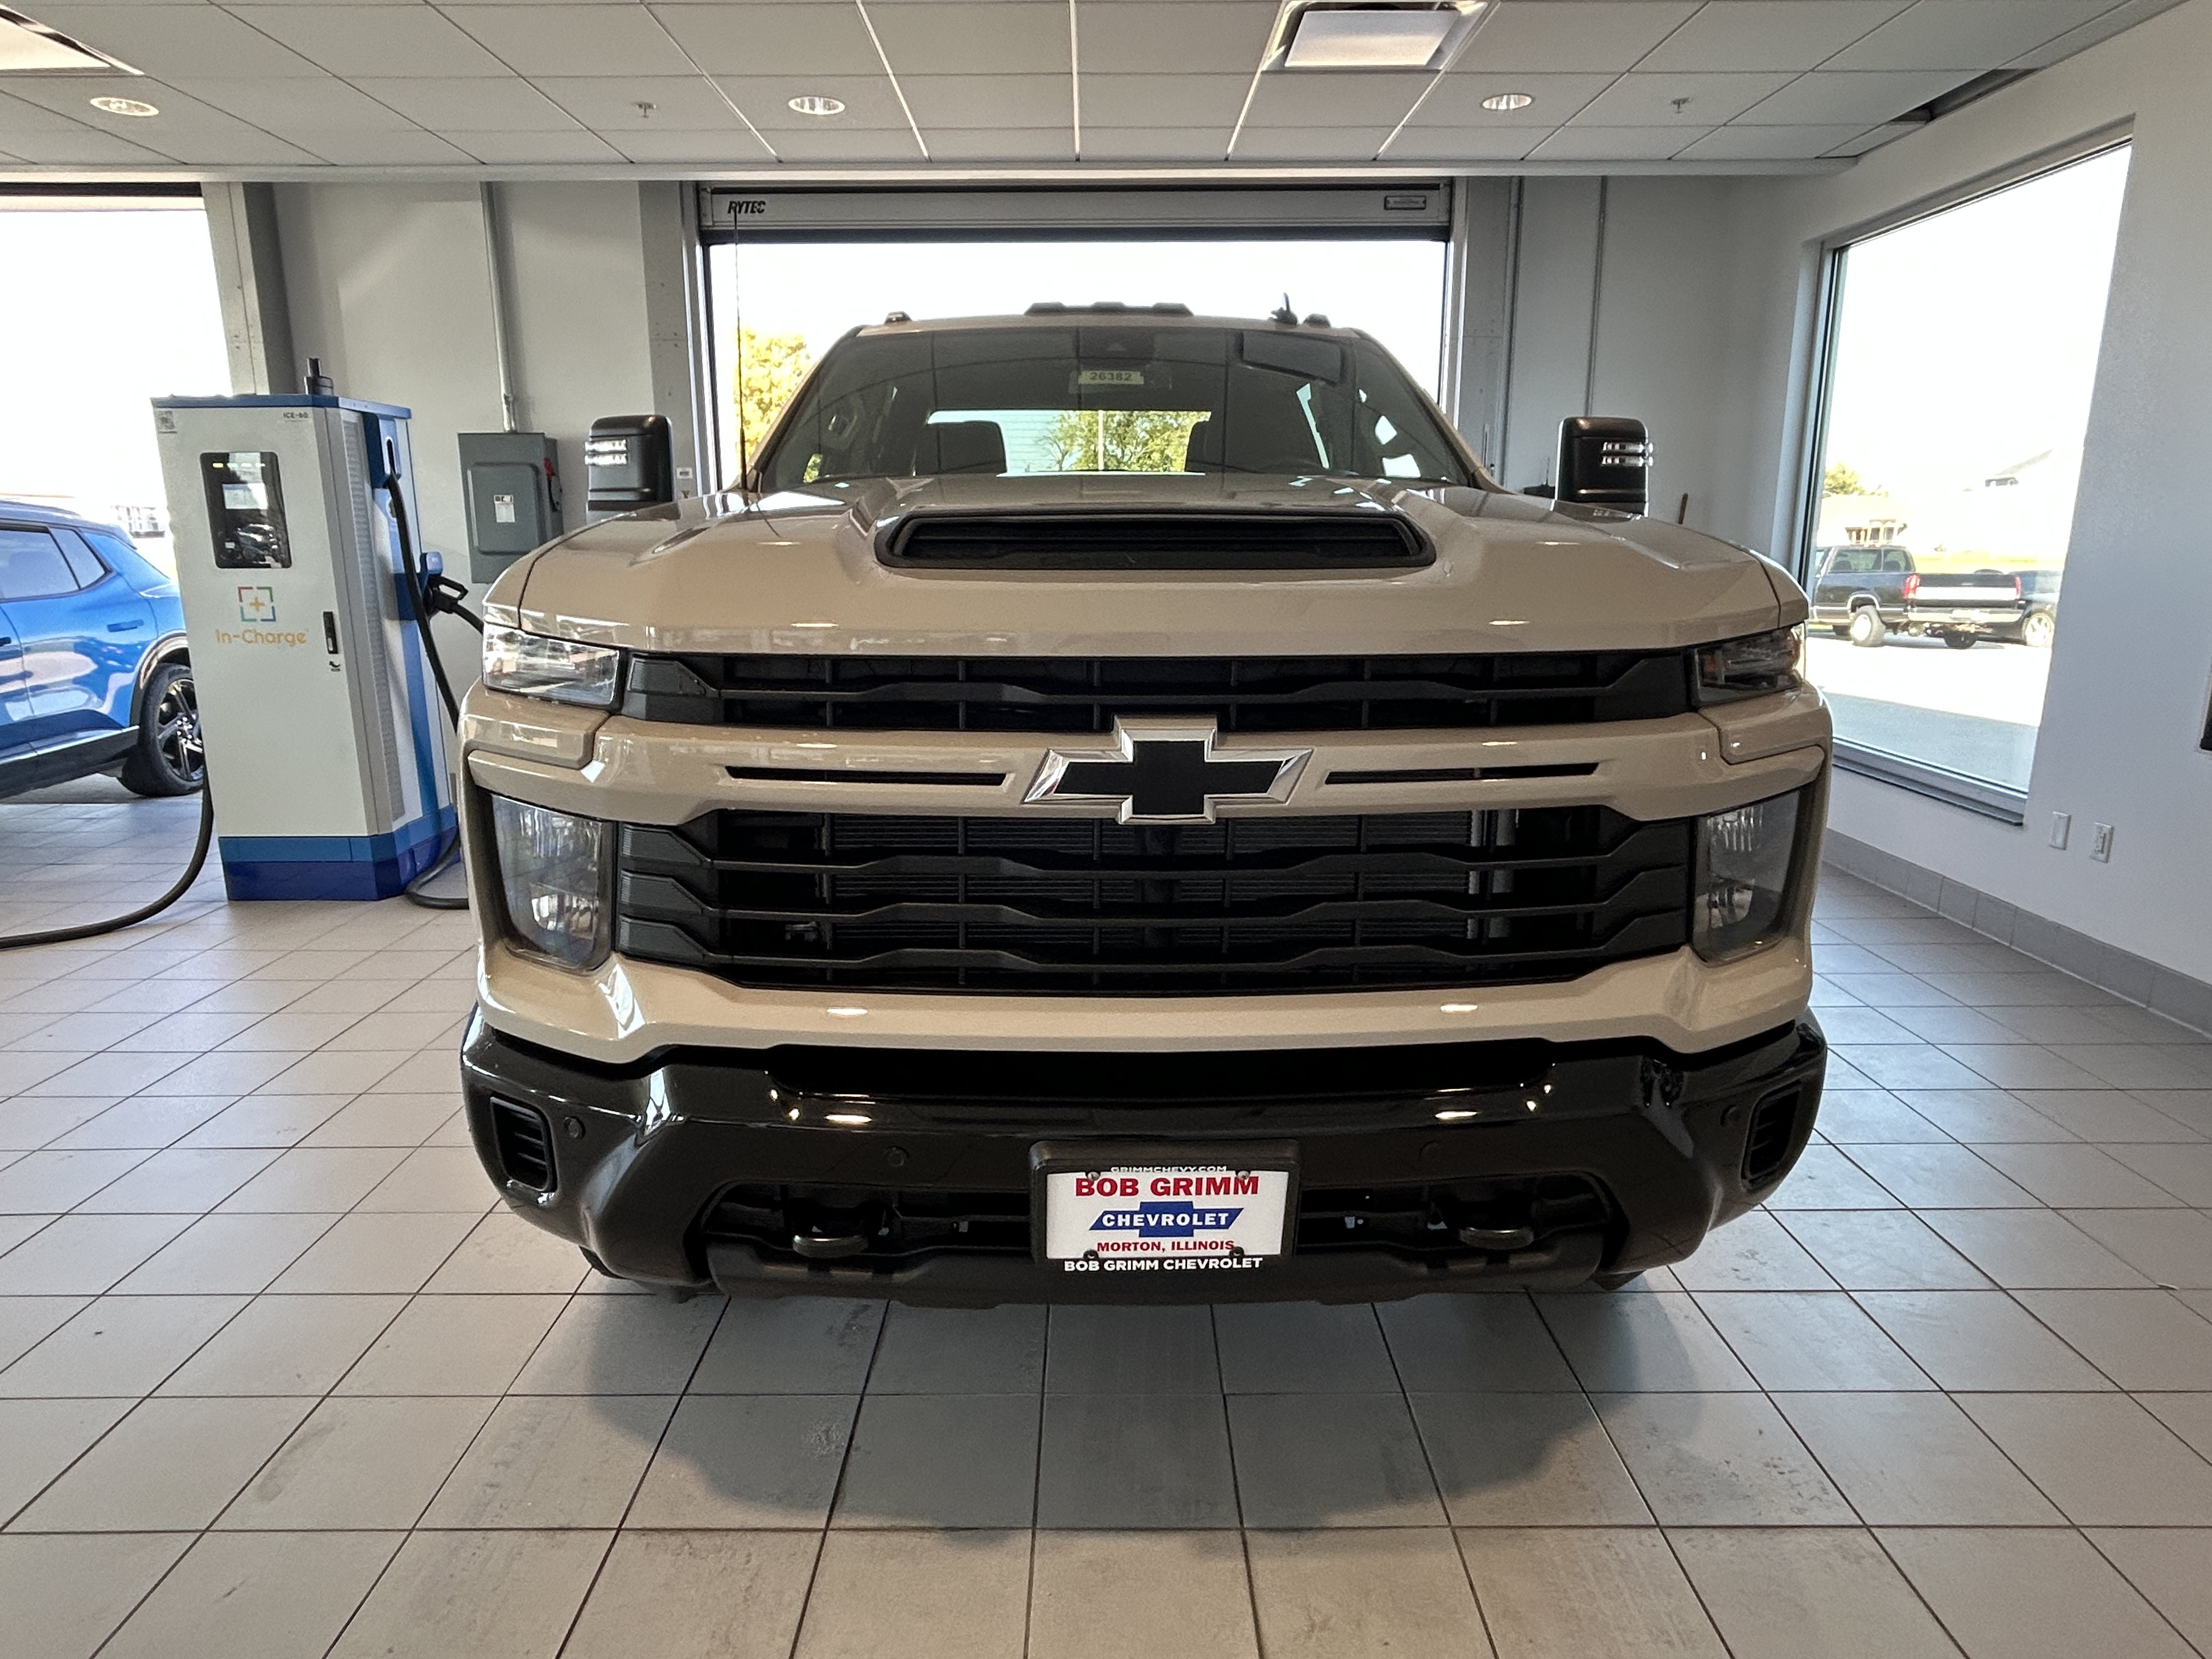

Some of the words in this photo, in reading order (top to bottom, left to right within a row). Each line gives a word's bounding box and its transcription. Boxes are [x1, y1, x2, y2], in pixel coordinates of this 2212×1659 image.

[727, 201, 766, 214] RYTEC
[1090, 372, 1132, 381] 26382
[215, 629, 307, 647] In-Charge
[1075, 1178, 1139, 1197] BOB
[1150, 1176, 1259, 1196] GRIMM
[1102, 1212, 1229, 1227] CHEVROLET
[1097, 1242, 1165, 1252] MORTON,
[1171, 1240, 1235, 1251] ILLINOIS
[1064, 1260, 1099, 1272] BOB
[1104, 1259, 1159, 1271] GRIMM
[1163, 1257, 1263, 1269] CHEVROLET
